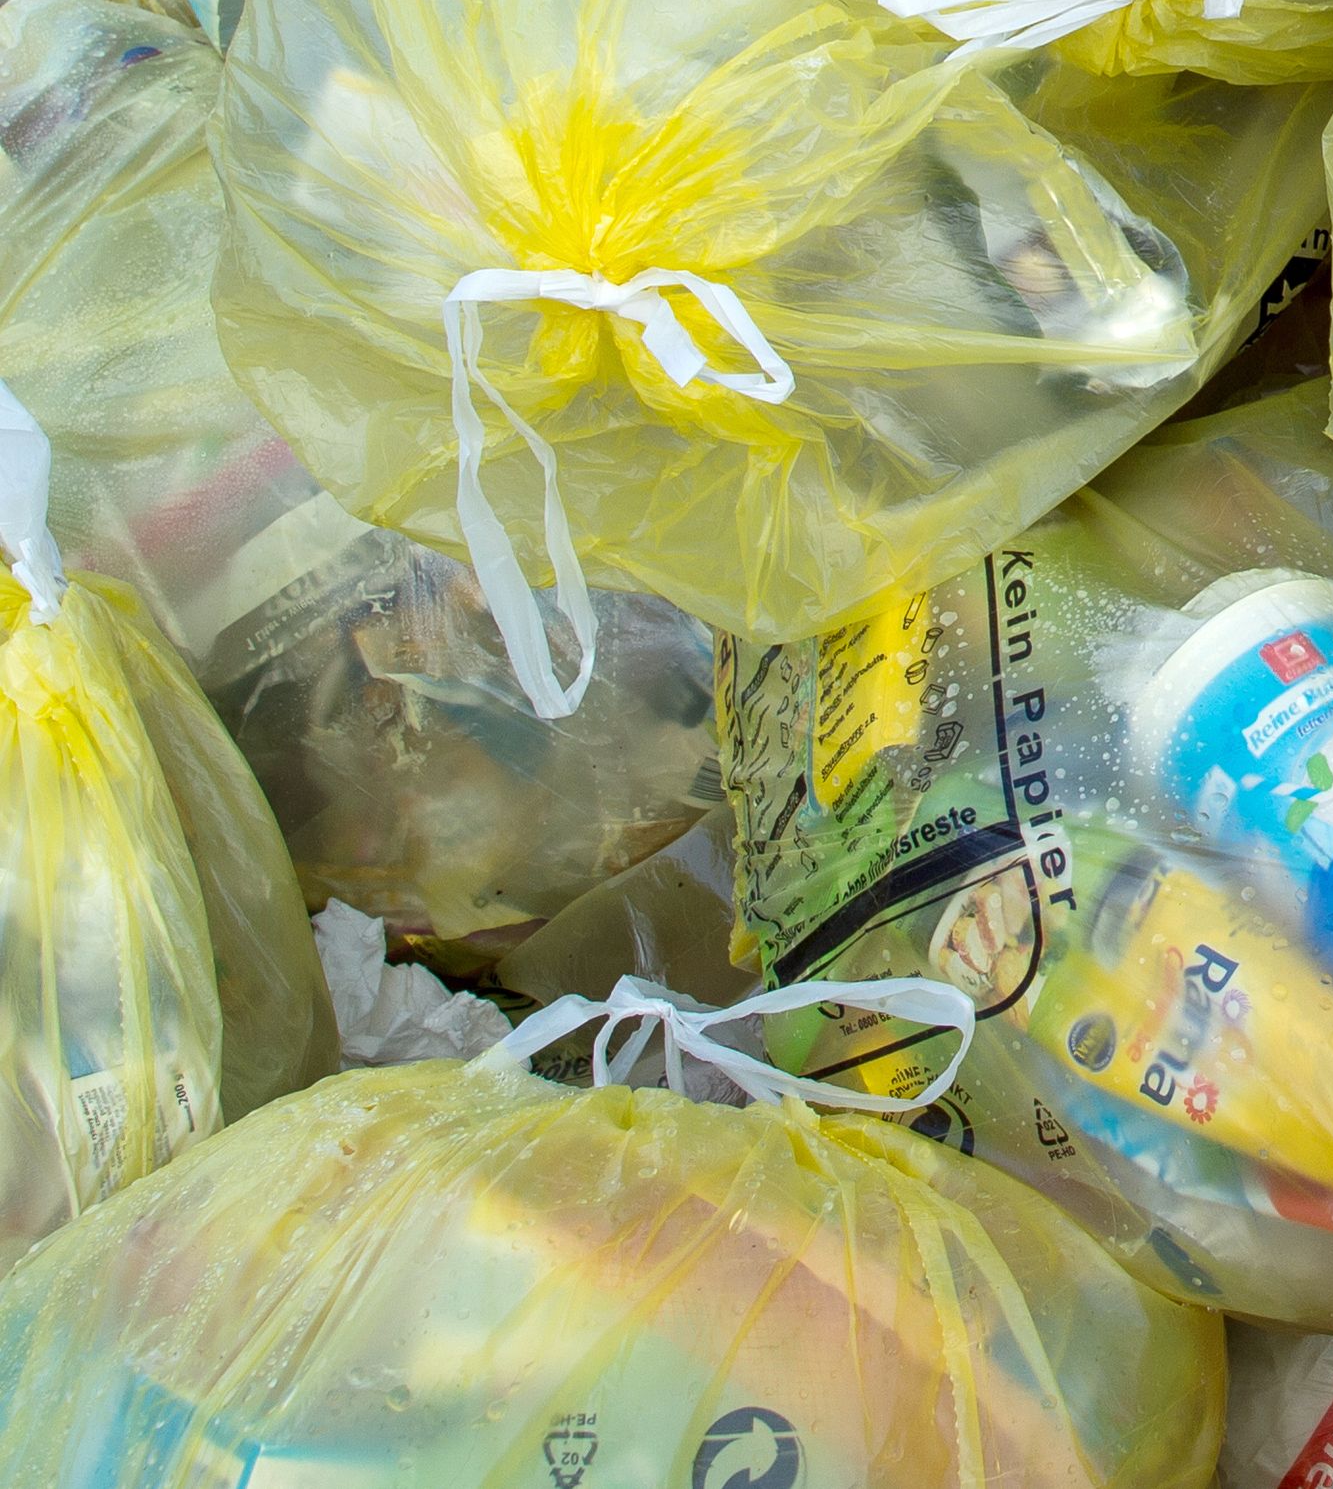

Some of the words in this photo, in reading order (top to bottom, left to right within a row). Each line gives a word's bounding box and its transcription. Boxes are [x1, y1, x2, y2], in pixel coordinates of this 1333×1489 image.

[1002, 549, 1038, 663] Kein
[1248, 698, 1299, 750] Reine
[1011, 687, 1078, 912] Papier
[174, 1083, 190, 1106] 200
[1047, 1145, 1077, 1162] PE-HD
